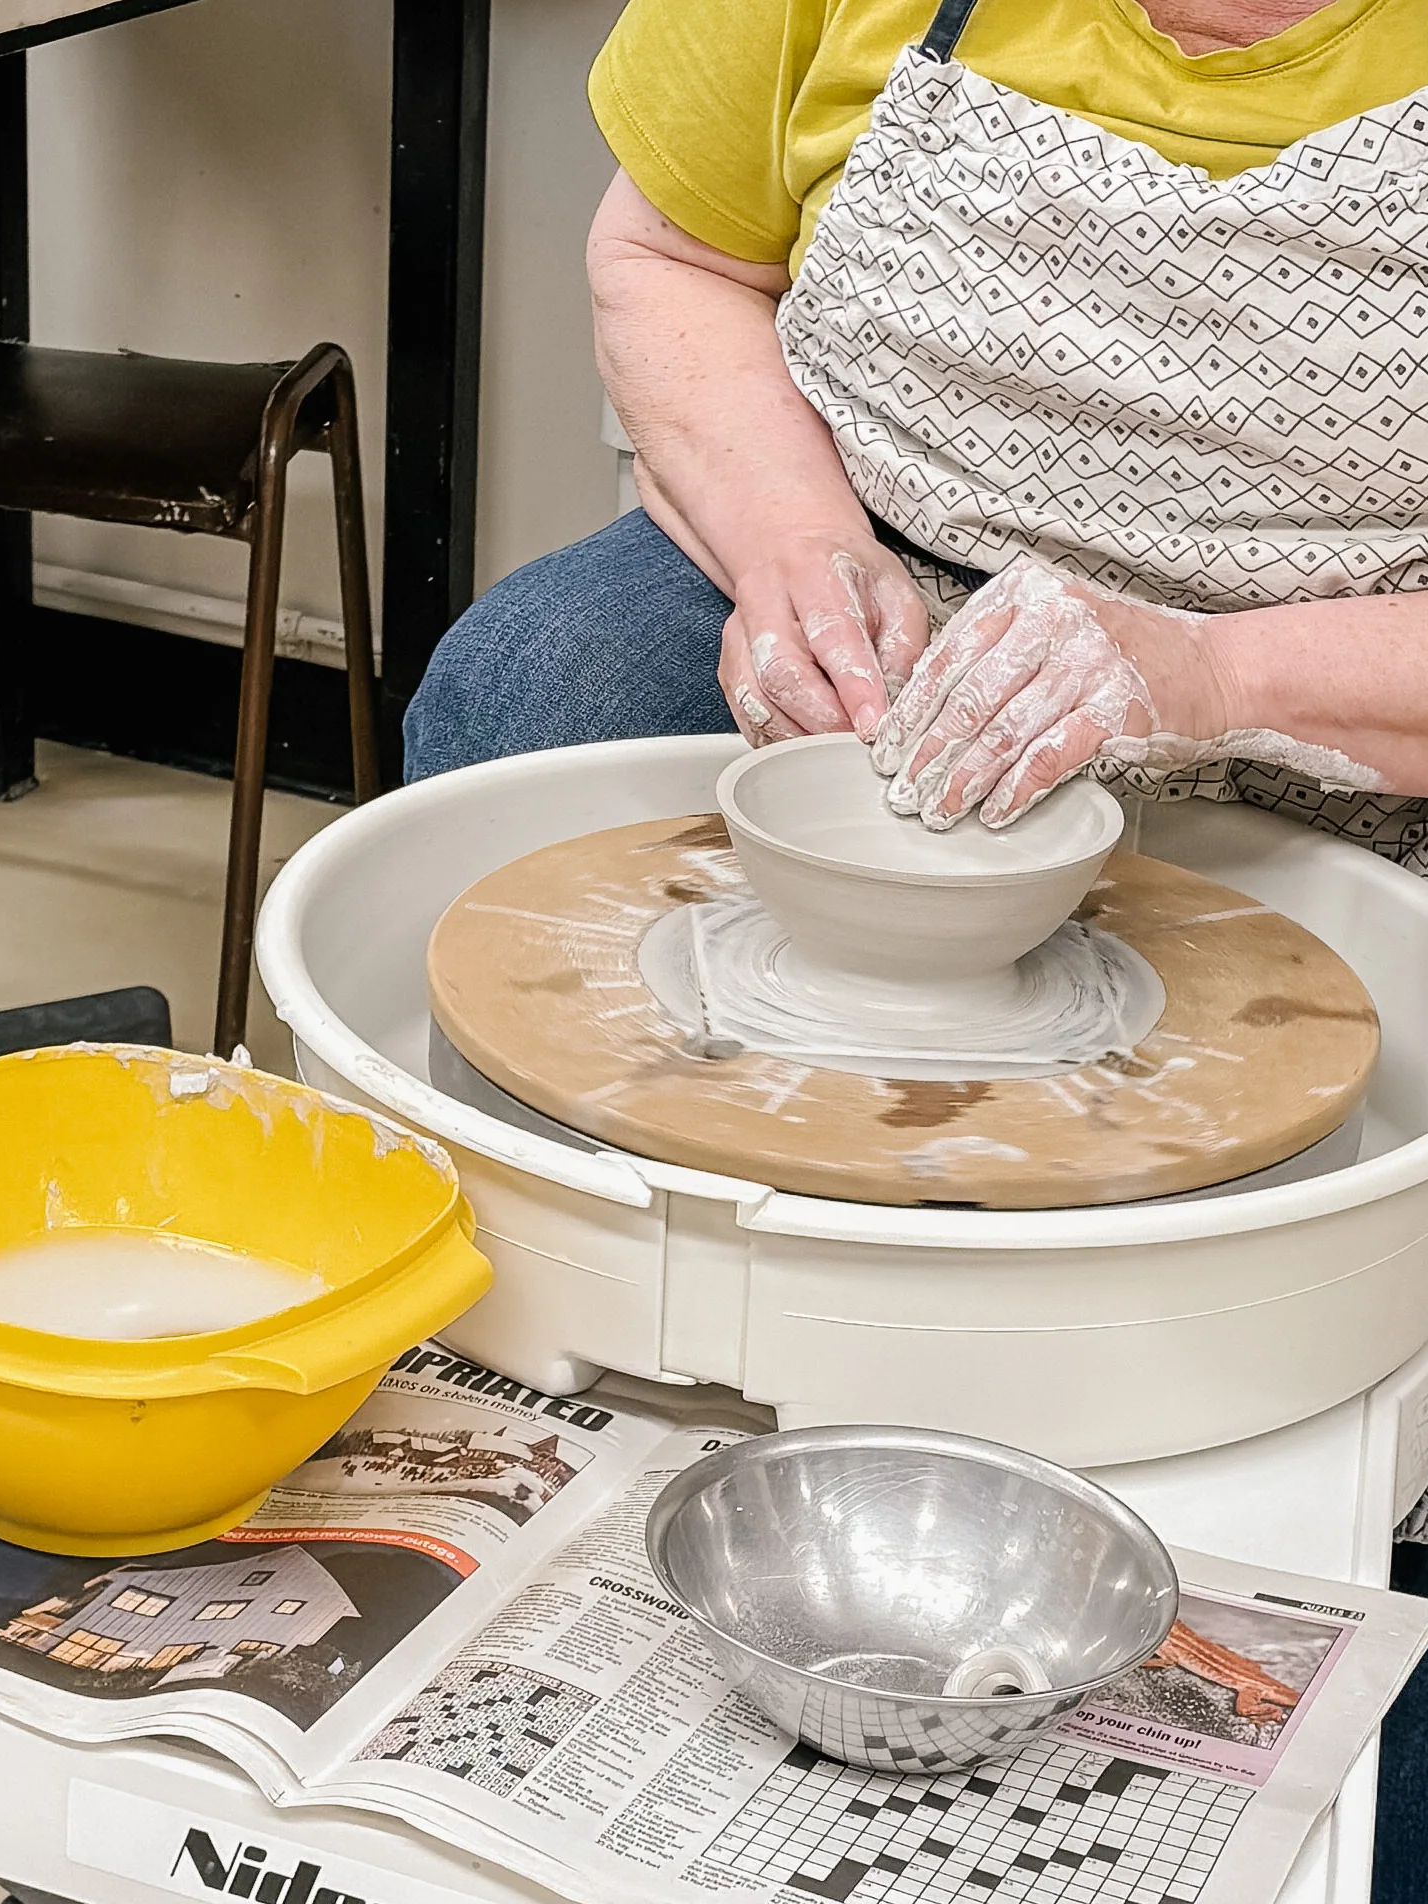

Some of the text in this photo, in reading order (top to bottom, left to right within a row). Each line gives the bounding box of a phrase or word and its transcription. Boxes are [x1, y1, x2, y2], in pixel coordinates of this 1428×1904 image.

[419, 1382, 442, 1397] on
[490, 1398, 543, 1422] money
[351, 1530, 405, 1543] power
[1096, 1714, 1134, 1733] your
[1136, 1724, 1172, 1742] chin
